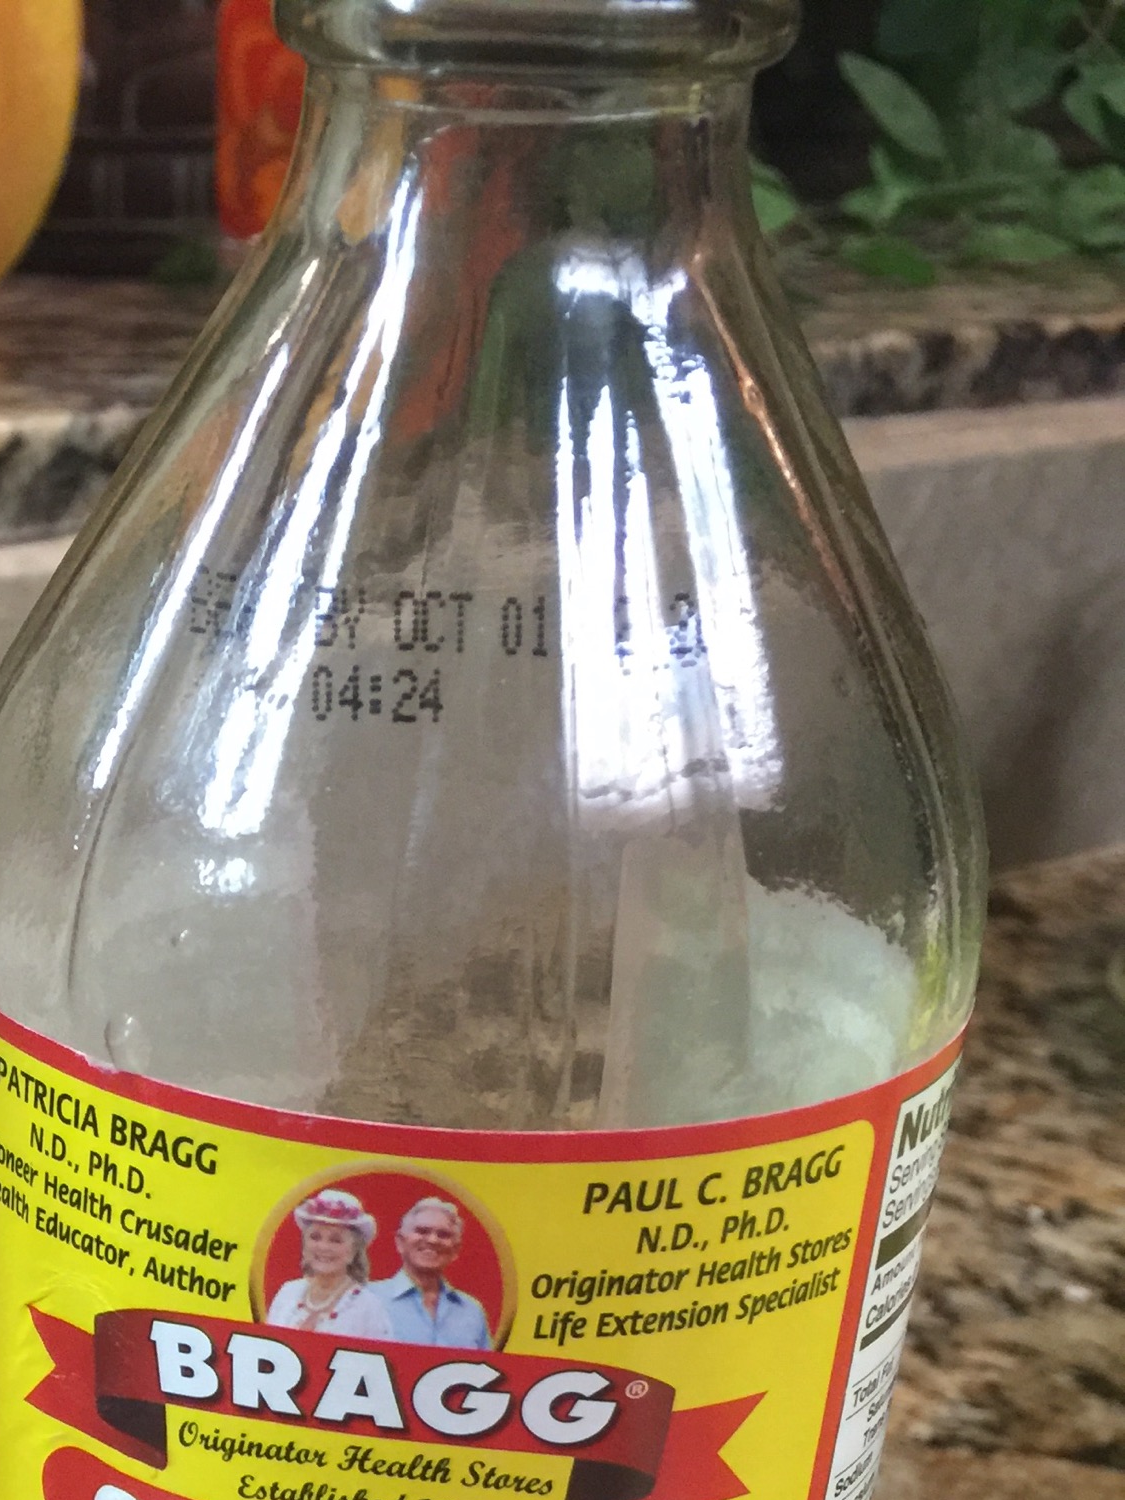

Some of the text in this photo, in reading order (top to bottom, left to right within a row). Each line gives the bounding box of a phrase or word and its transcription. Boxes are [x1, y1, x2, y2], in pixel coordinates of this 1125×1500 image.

[393, 590, 473, 653] OCT
[500, 596, 548, 657] 01
[311, 664, 444, 723] 04:24
[29, 1122, 152, 1200] N.D., Ph.D.
[110, 1114, 219, 1176] BRAGG
[582, 1143, 845, 1215] PAUL C. BRAGG
[43, 1165, 112, 1224] Health
[120, 1203, 238, 1263] Crusader
[636, 1207, 790, 1254] N.D., Ph.D.
[35, 1204, 135, 1278] Educator,
[143, 1255, 236, 1303] Author
[531, 1226, 853, 1305] Originator Health Stores
[533, 1266, 842, 1347] Life Extension Specialist
[148, 1319, 618, 1445] BRAGG
[176, 1420, 554, 1498] Originator Health Stores
